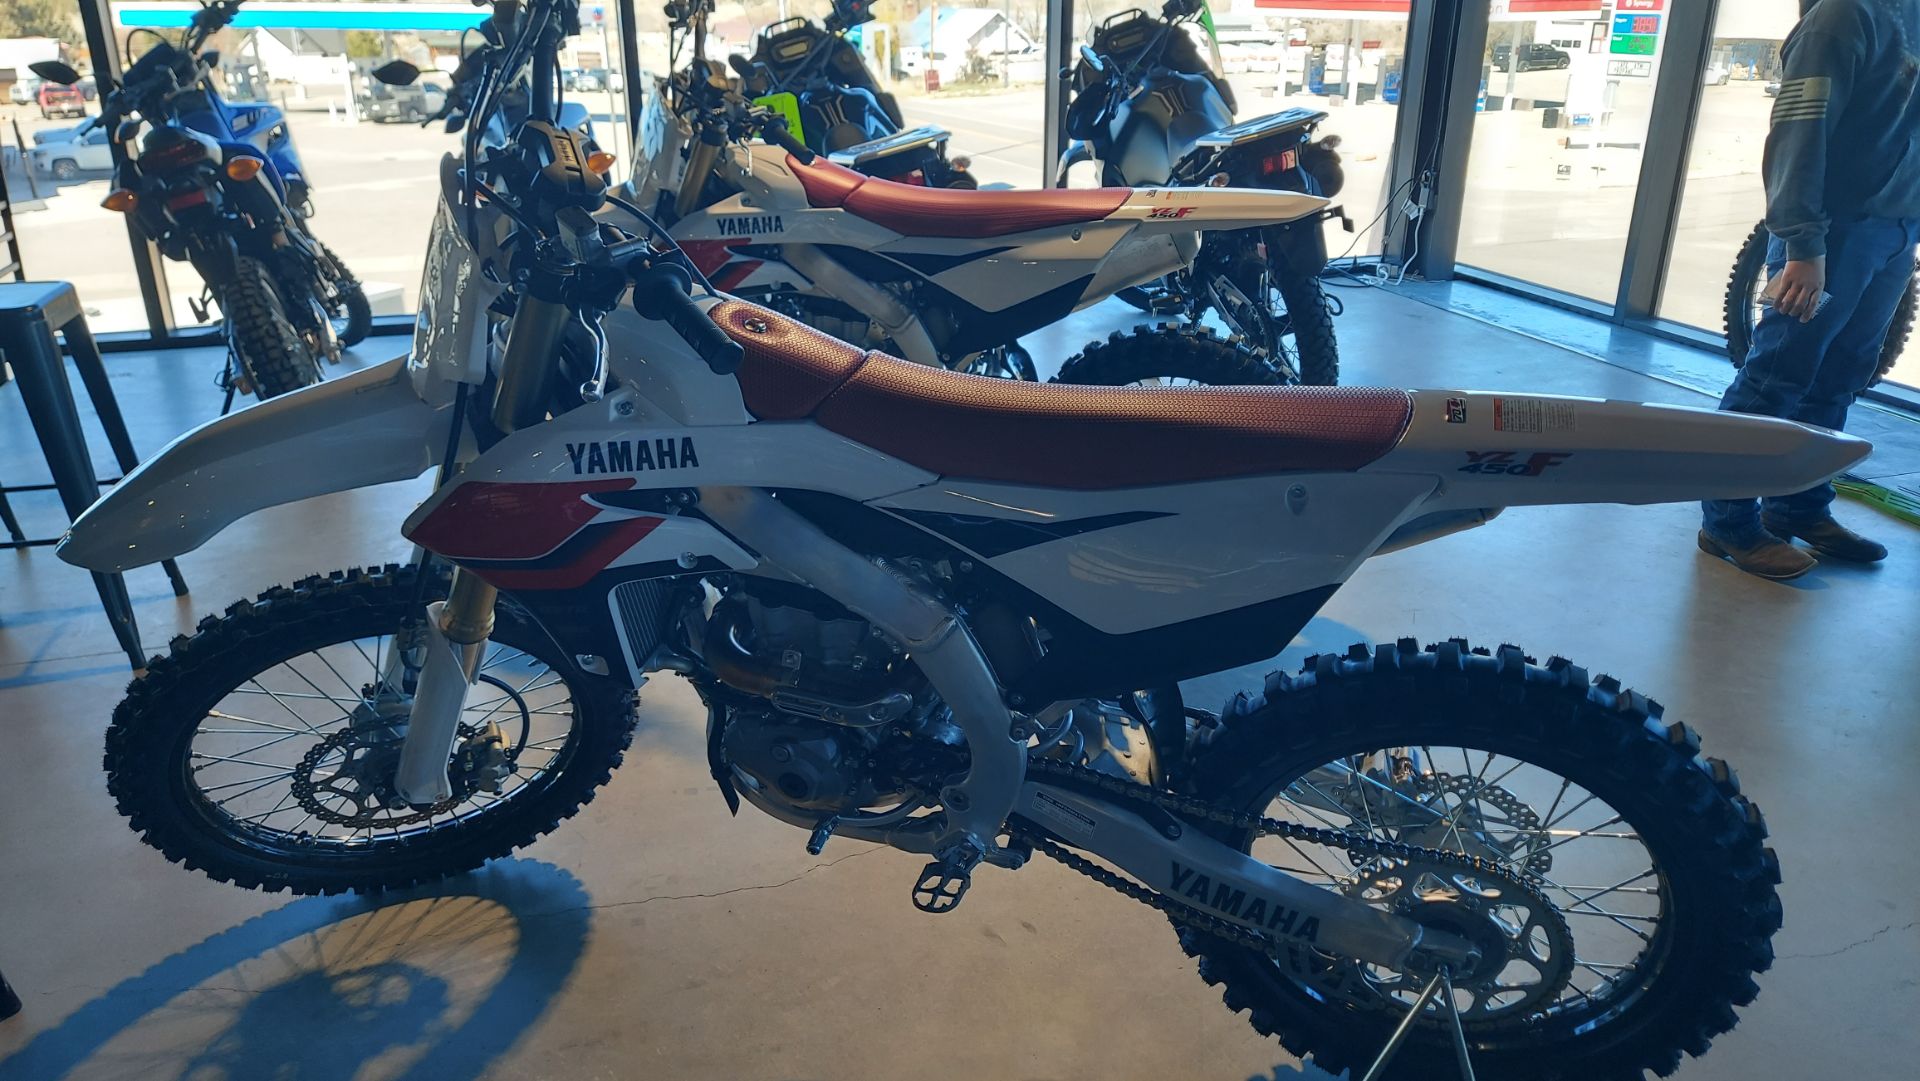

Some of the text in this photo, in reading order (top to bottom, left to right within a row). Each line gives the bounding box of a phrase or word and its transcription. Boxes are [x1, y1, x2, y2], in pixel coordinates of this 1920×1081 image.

[716, 215, 784, 236] YAMAHA
[566, 437, 699, 474] YAMAHA
[1170, 861, 1320, 942] YAMAHA
